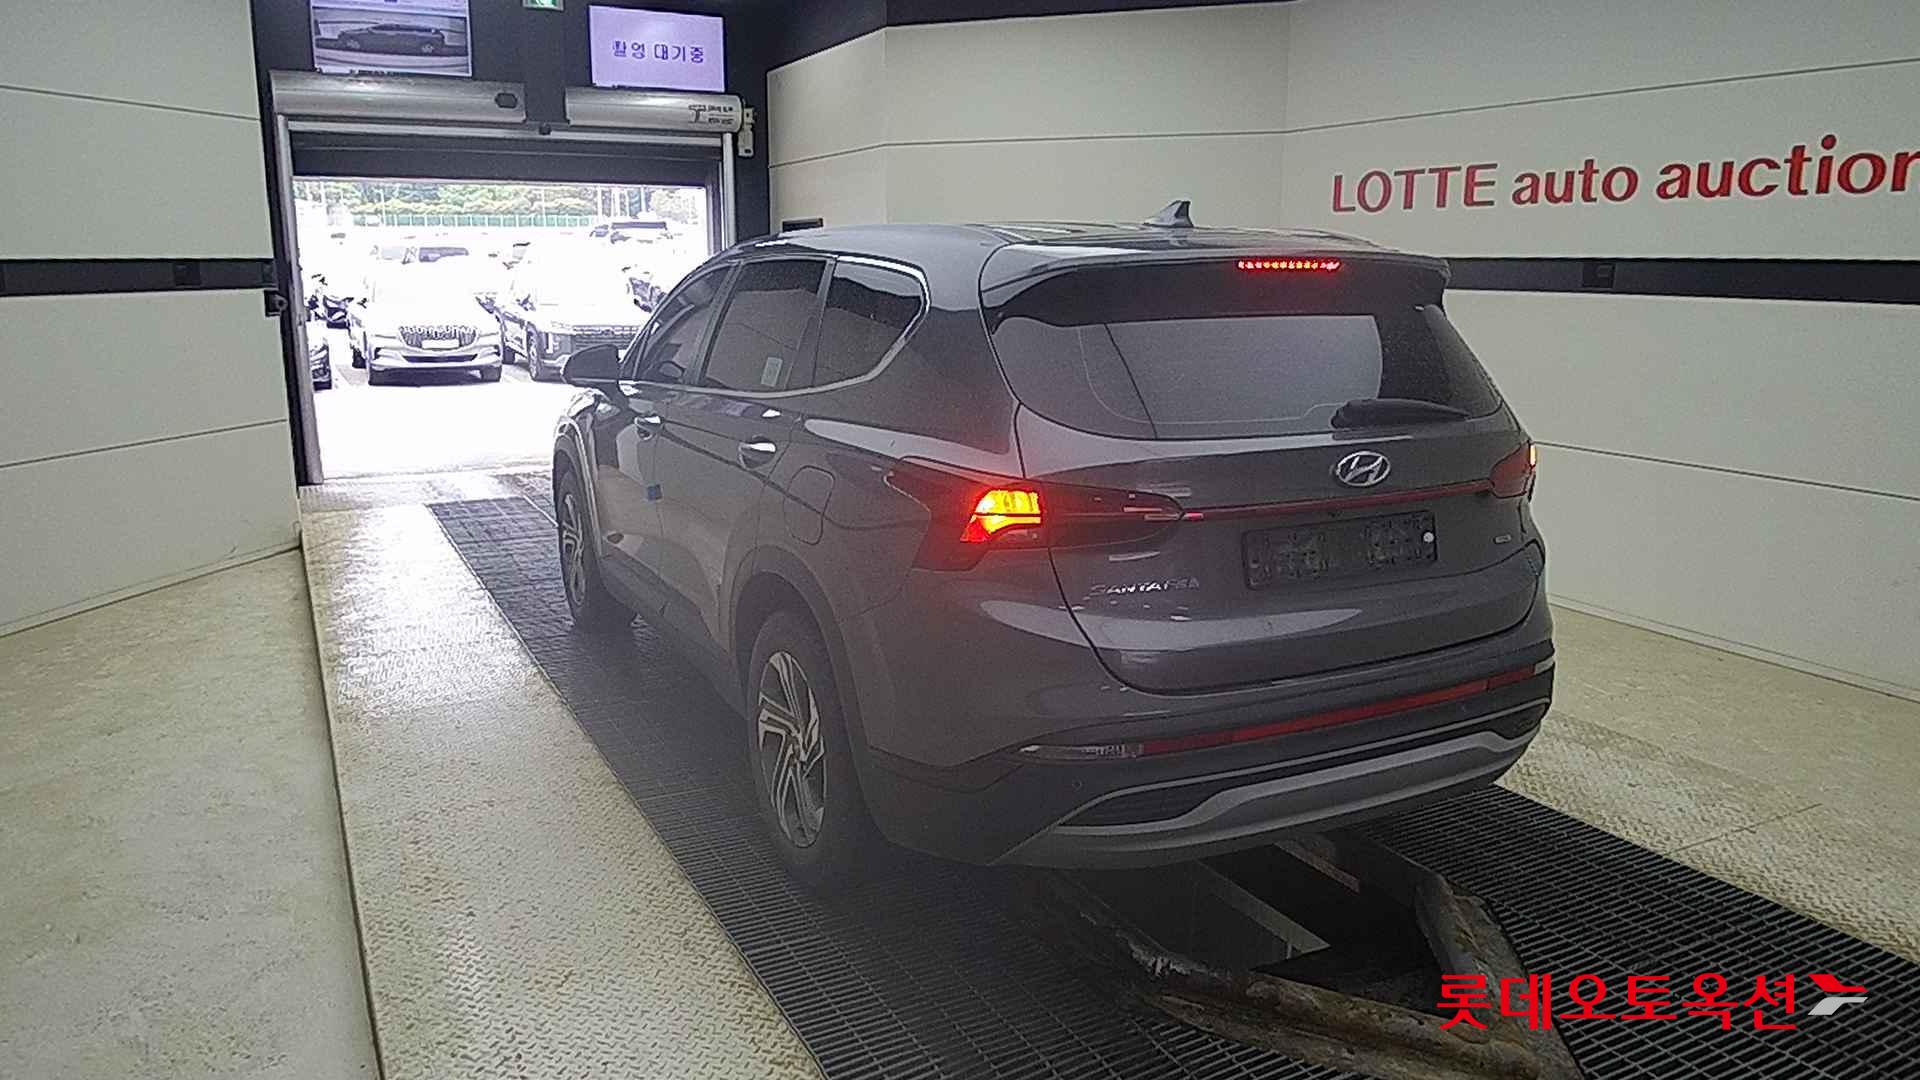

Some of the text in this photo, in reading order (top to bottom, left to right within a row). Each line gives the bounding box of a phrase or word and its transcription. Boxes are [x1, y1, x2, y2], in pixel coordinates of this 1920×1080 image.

[654, 43, 704, 64] 대기중
[1332, 163, 1498, 212] LOTTE
[1512, 159, 1639, 206] auto
